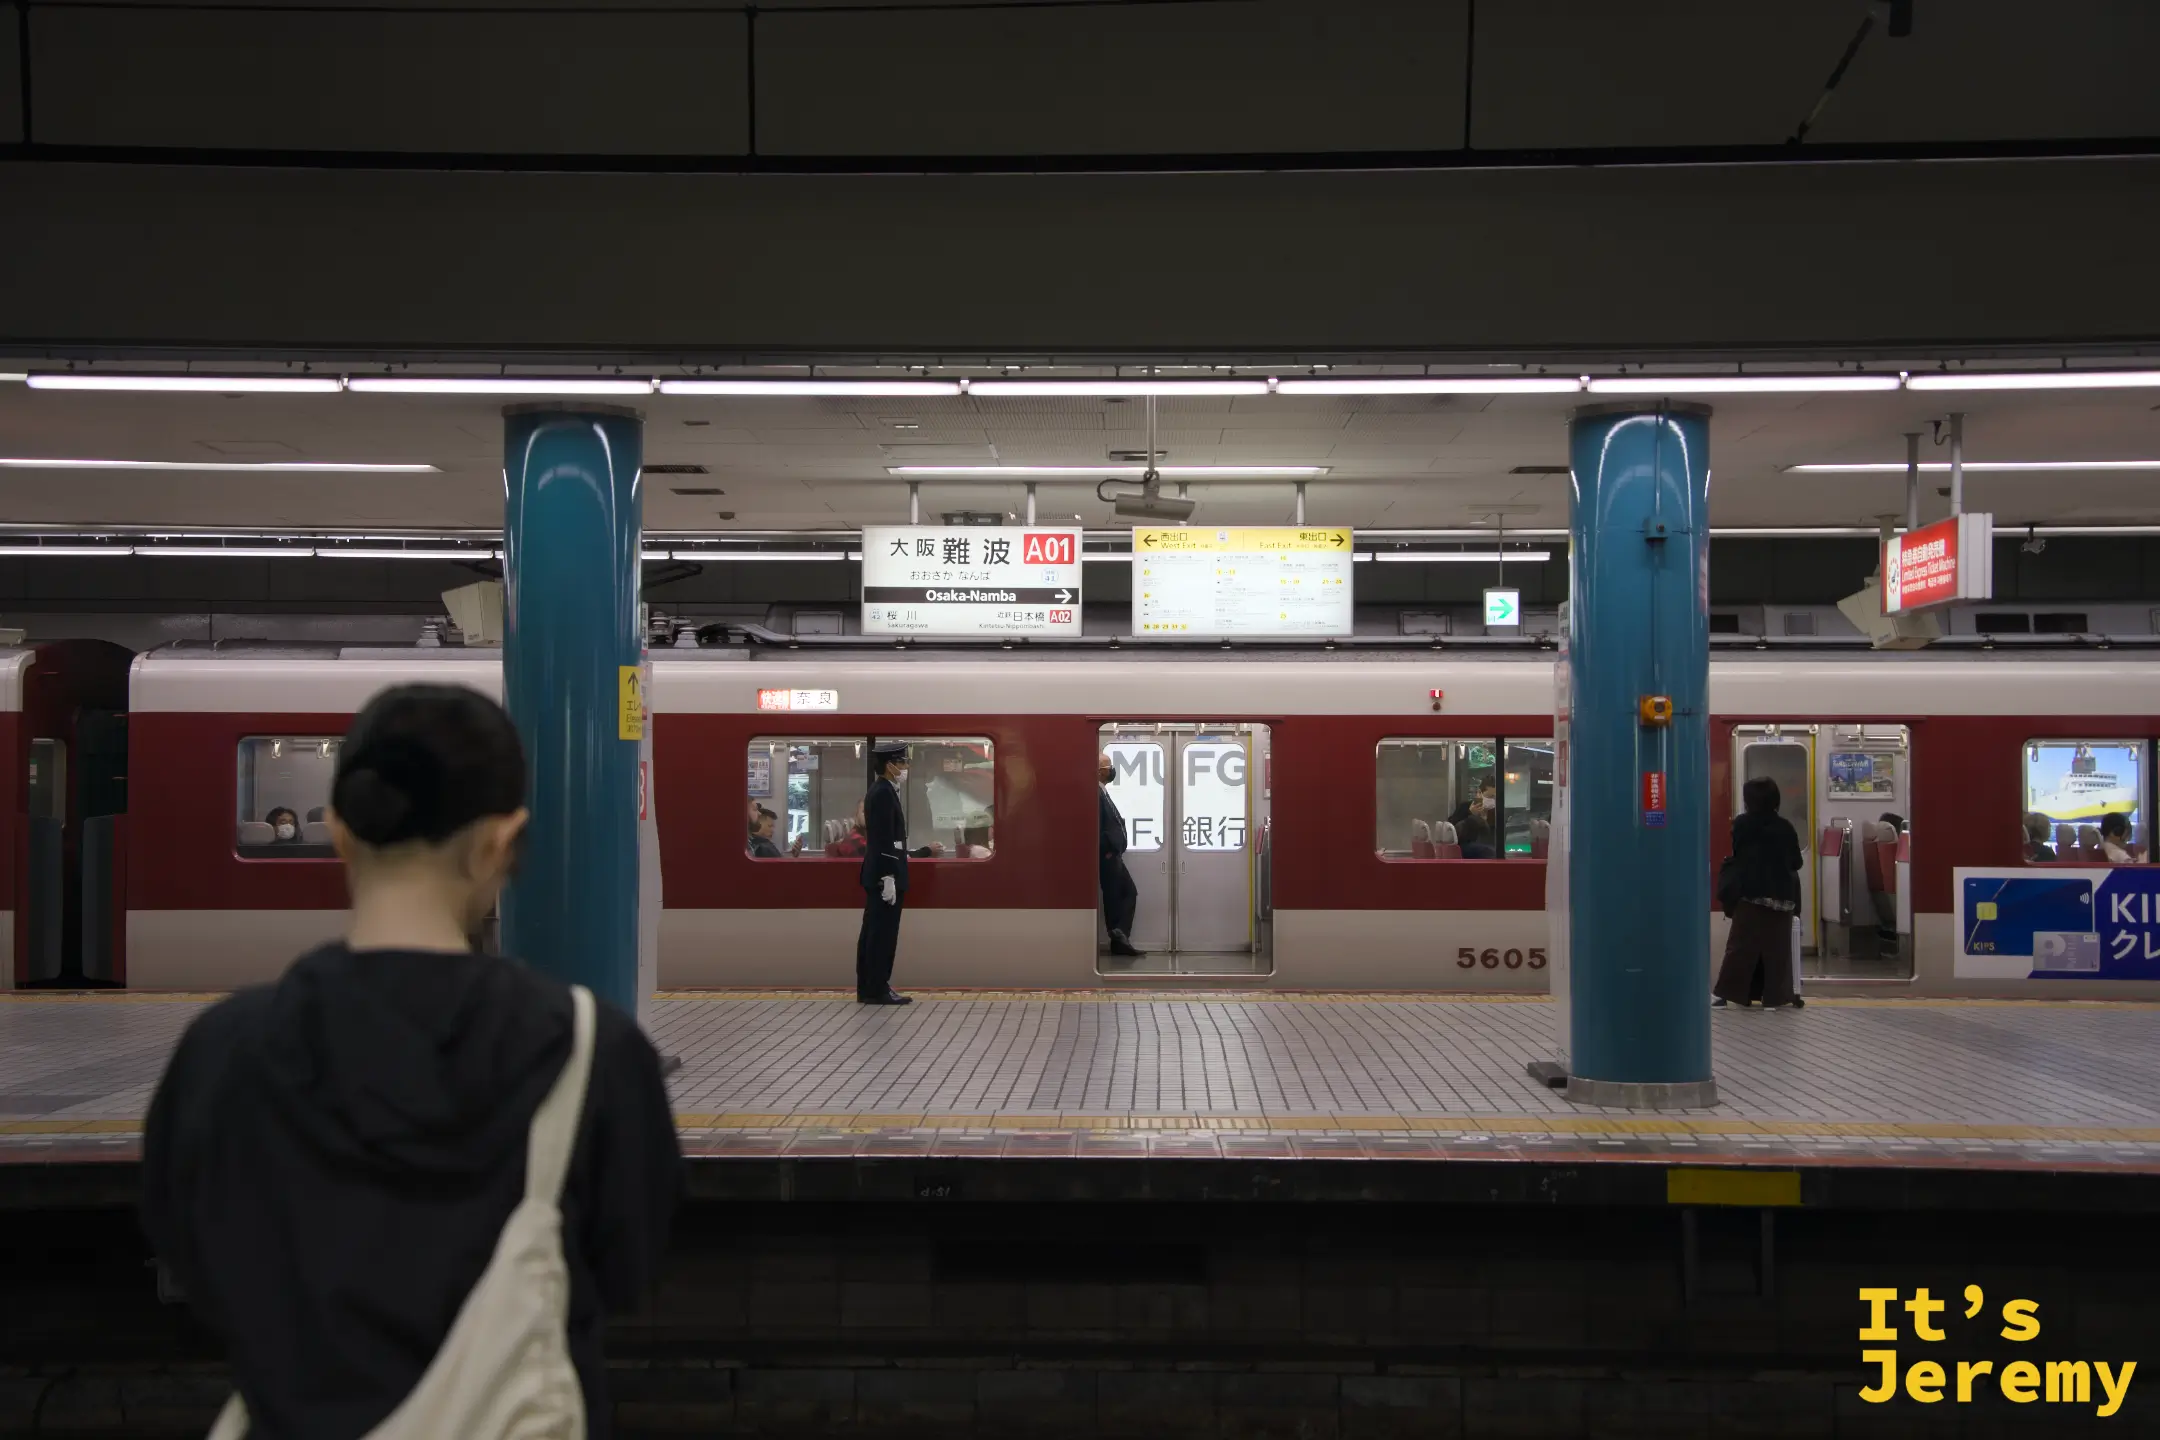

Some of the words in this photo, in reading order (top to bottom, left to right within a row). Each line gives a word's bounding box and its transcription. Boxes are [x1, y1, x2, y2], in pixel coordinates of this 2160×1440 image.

[1161, 532, 1187, 541] 西出口
[1299, 532, 1326, 541] 東出口
[890, 538, 1010, 565] 大阪難波
[1026, 537, 1070, 562] A01
[910, 571, 952, 581] おおさか
[959, 571, 991, 581] なんば
[926, 589, 1016, 602] Osaka-Namba
[887, 611, 917, 621] 桜川
[1050, 611, 1071, 623] A02
[797, 692, 831, 705] 奈良
[2111, 893, 2160, 923] KI
[1457, 947, 1546, 969] 5605
